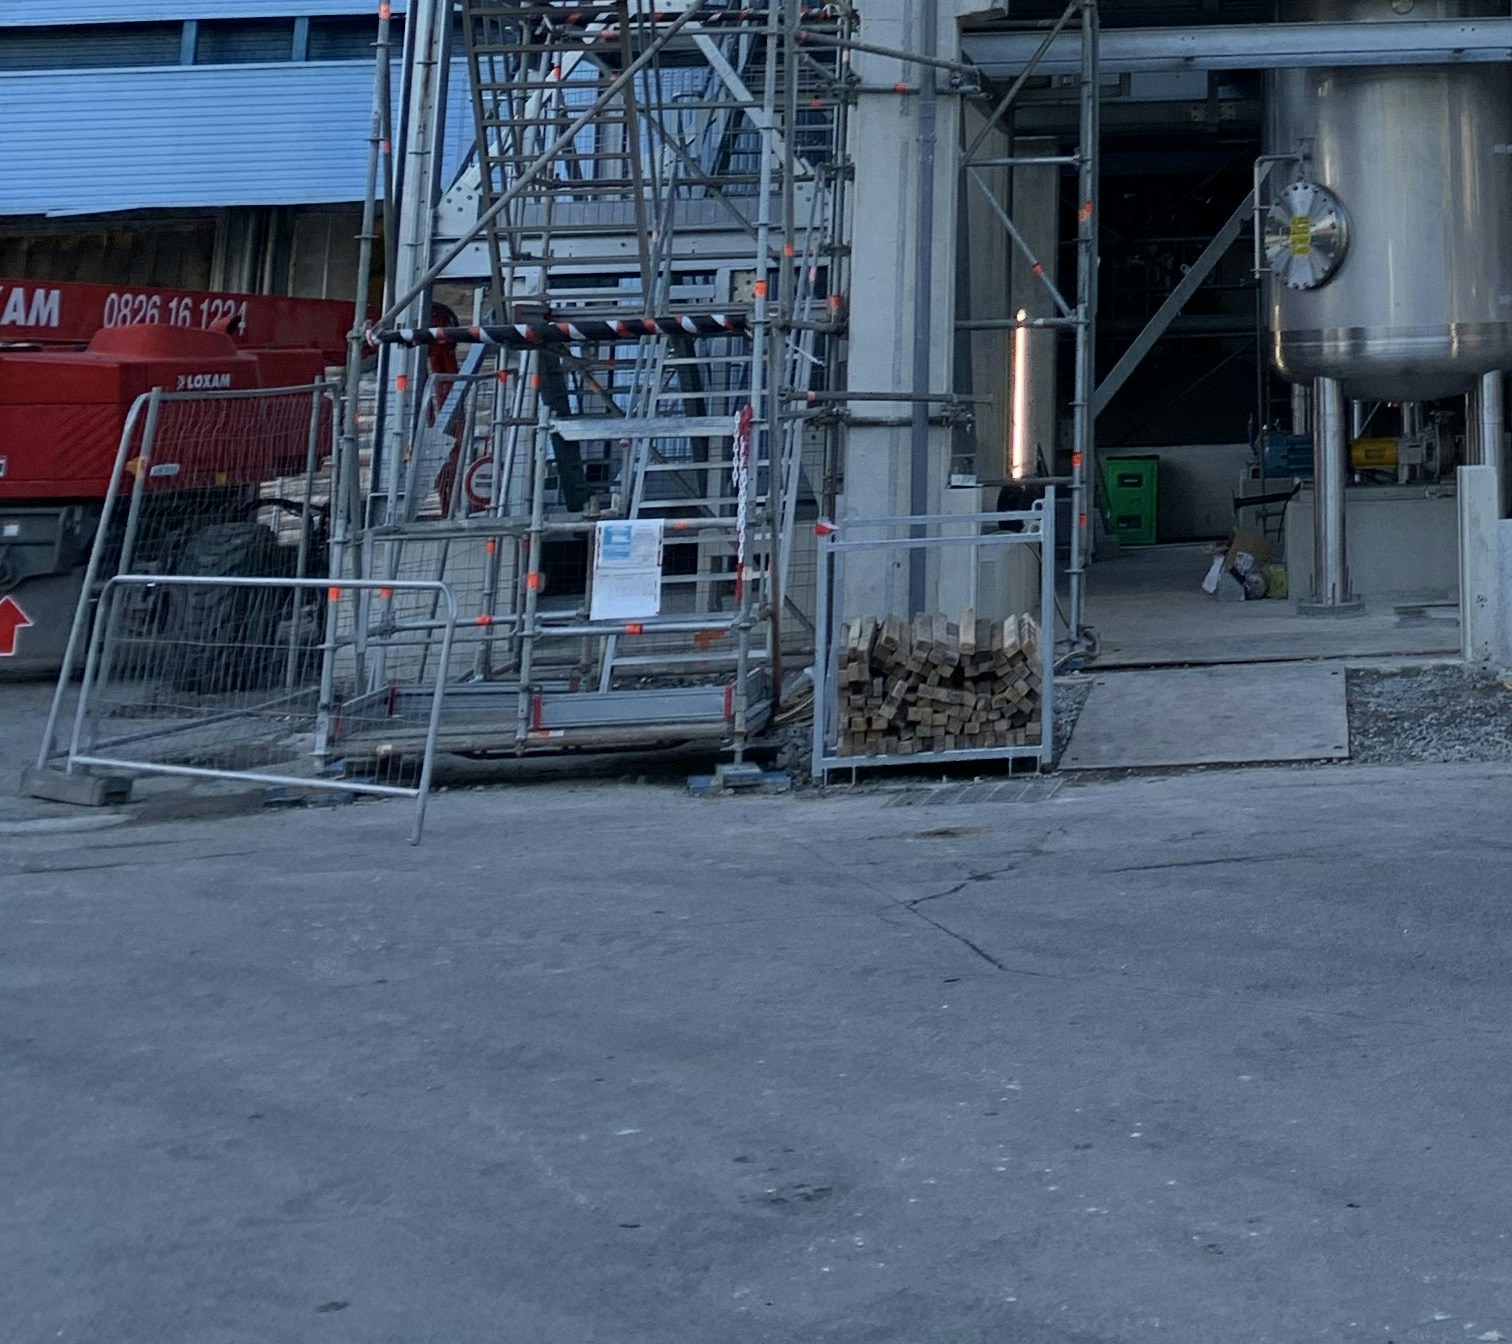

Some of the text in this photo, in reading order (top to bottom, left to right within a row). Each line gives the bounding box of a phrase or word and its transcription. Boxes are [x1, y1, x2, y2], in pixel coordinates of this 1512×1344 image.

[103, 292, 161, 328] 0826
[168, 296, 193, 328] 16
[187, 373, 231, 389] LOXAM
